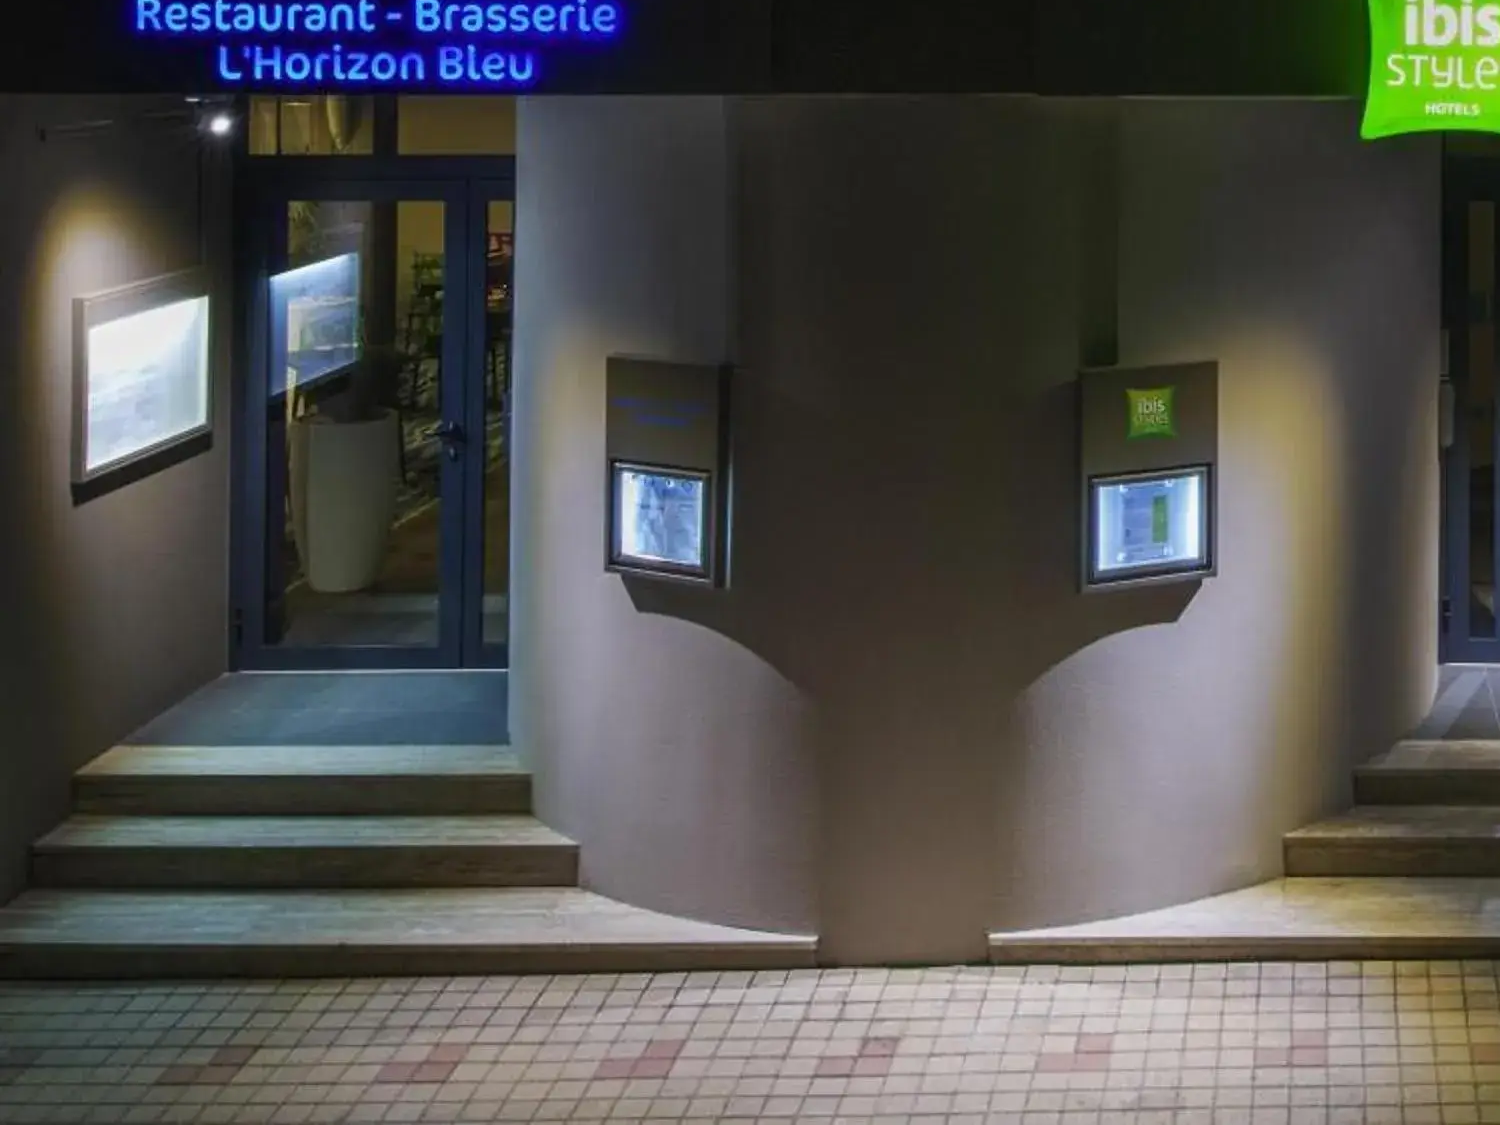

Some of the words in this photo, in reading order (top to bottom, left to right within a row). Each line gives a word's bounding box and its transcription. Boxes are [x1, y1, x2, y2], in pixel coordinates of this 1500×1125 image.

[219, 44, 425, 81] L'Horizon
[438, 44, 534, 81] Bleu
[1425, 102, 1480, 116] HOTELS
